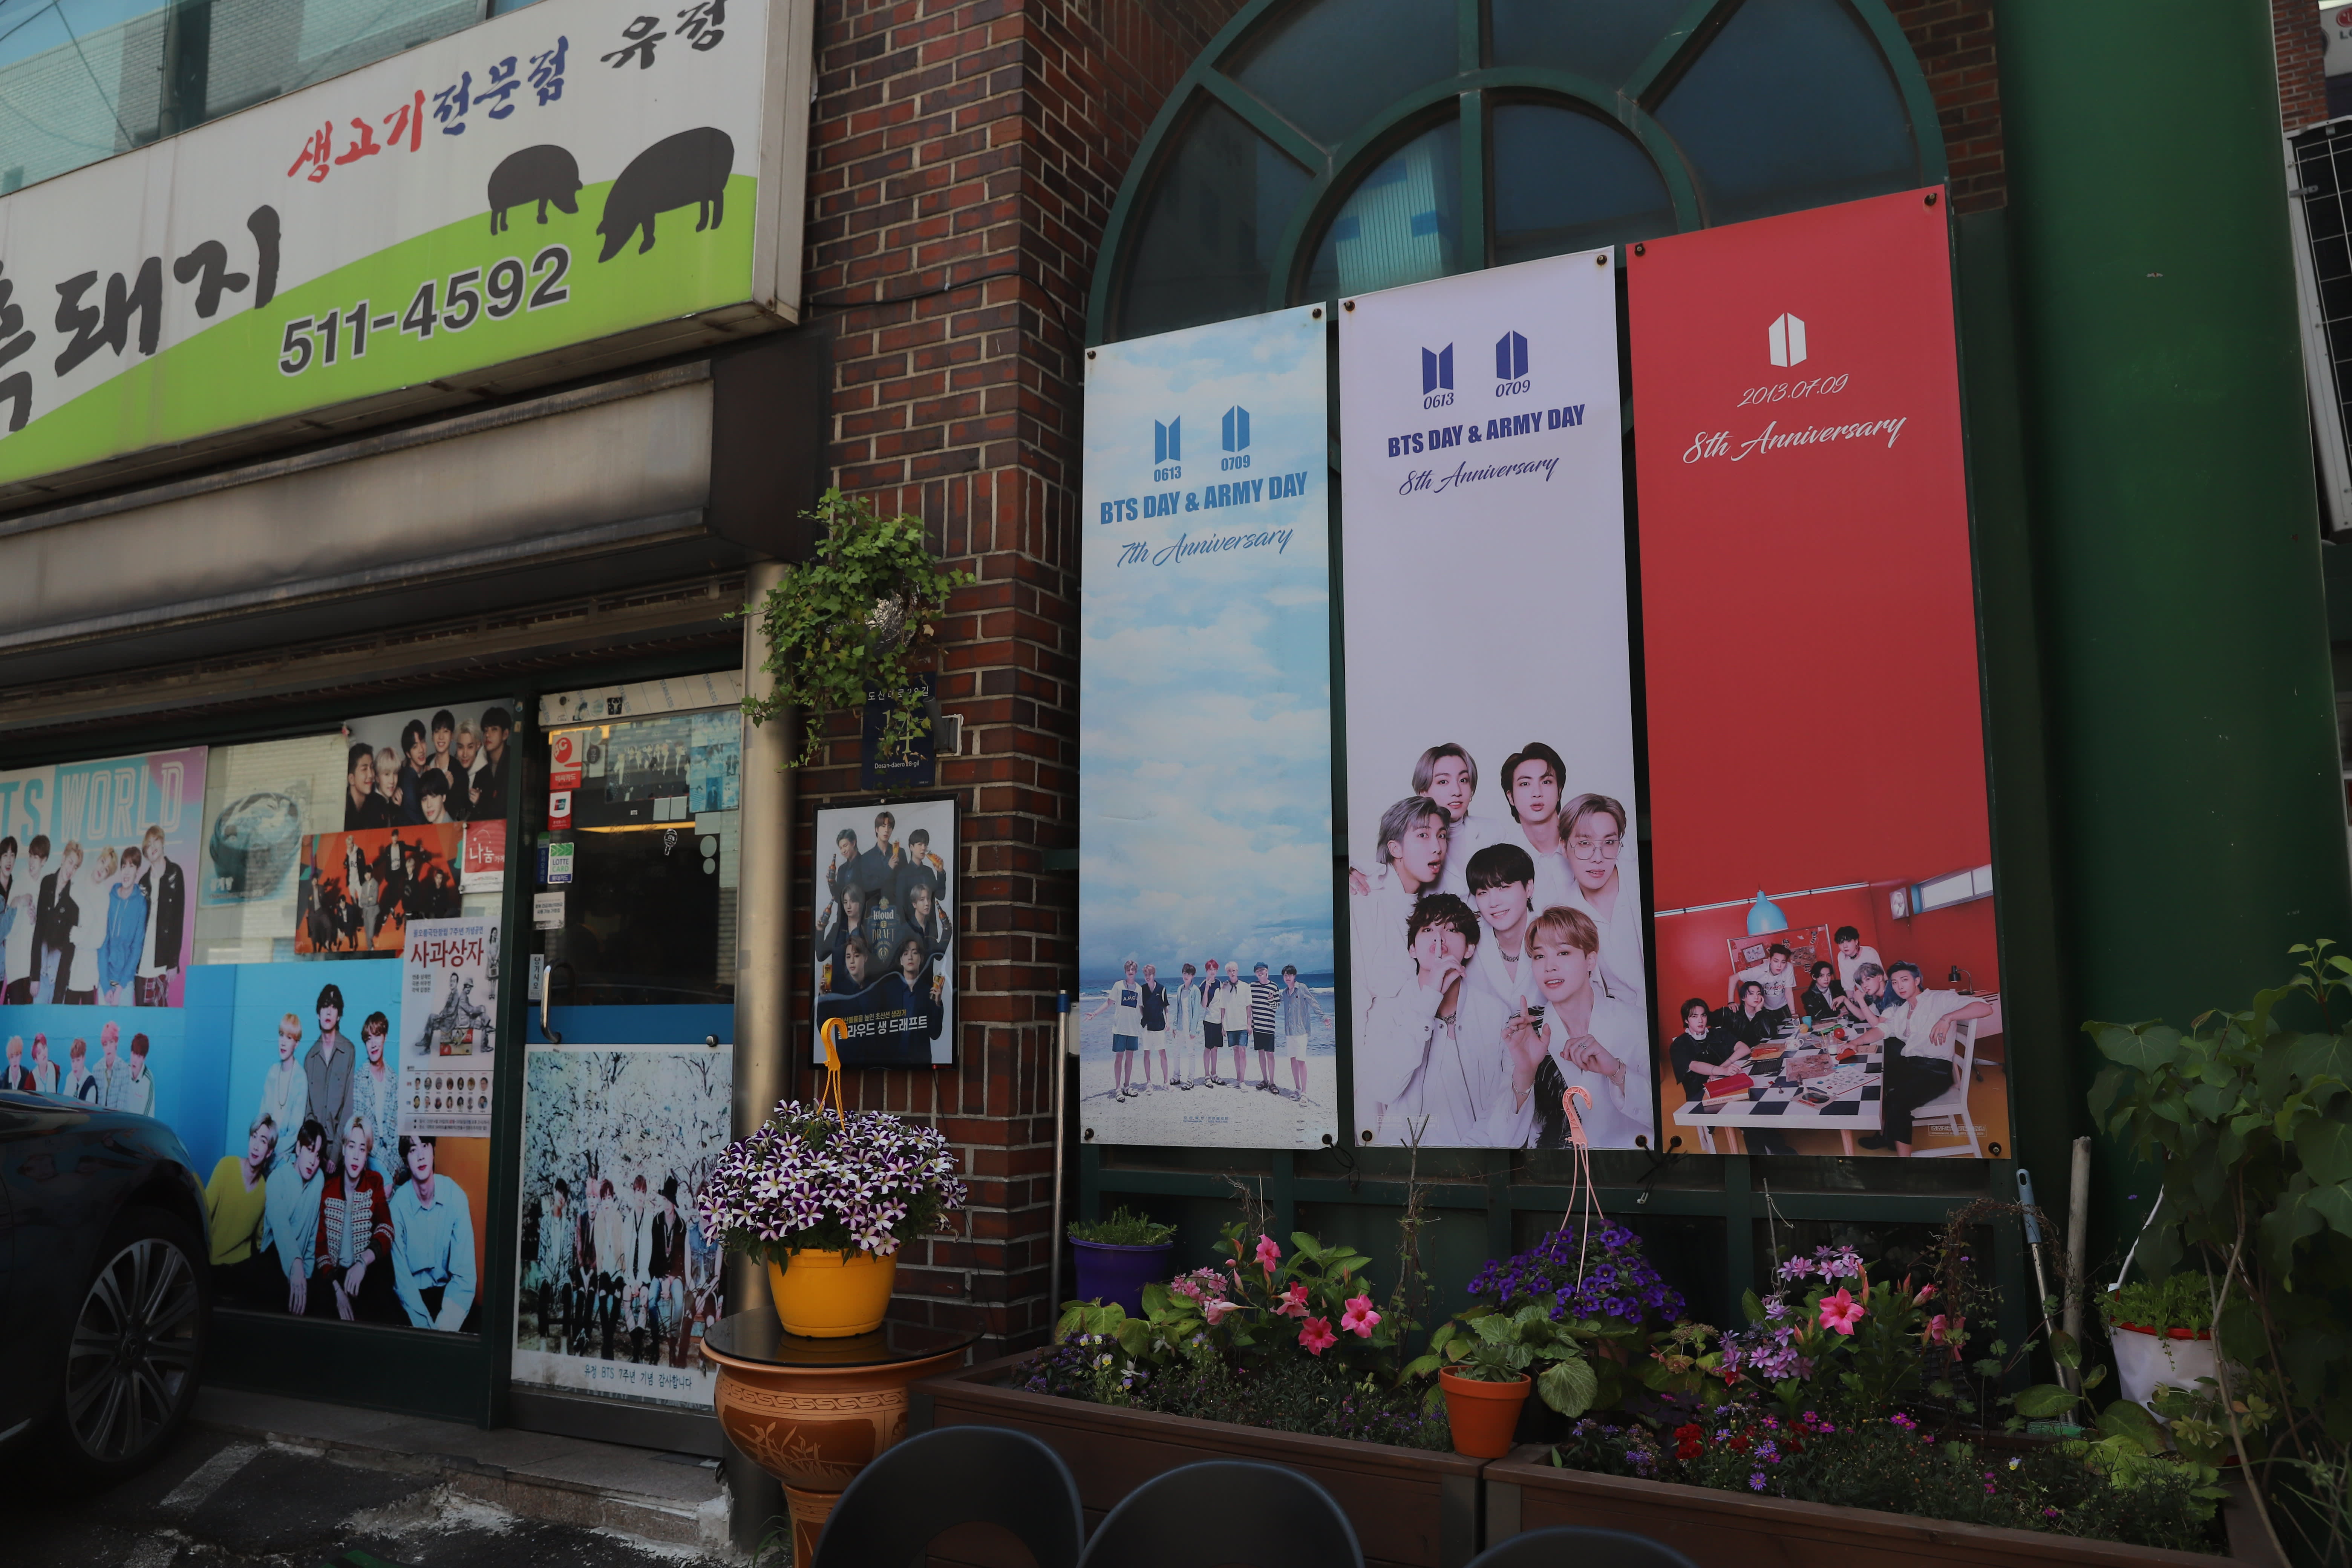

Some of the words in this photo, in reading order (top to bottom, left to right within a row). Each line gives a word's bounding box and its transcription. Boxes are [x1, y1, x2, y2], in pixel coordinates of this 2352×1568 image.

[2340, 27, 2352, 40] L
[279, 244, 570, 376] 511-4592
[1495, 380, 1530, 397] 0709
[1736, 373, 1849, 407] 2013.07.09
[1423, 392, 1454, 409] 0613
[1388, 433, 1424, 458] BTS
[1429, 425, 1463, 451] DAY
[1468, 426, 1482, 443] &
[1486, 411, 1542, 440] ARMY
[1548, 404, 1585, 430] DAY
[1682, 431, 1735, 464] 8th
[1730, 416, 1907, 462] Anniversary
[1154, 466, 1182, 482] 0613
[1221, 455, 1250, 471] 0709
[1399, 470, 1434, 495] 8th
[1433, 457, 1559, 493] Anniversary
[1100, 498, 1138, 525] BTS
[1144, 492, 1180, 518] DAY
[1185, 492, 1199, 512] &
[1204, 478, 1263, 509] ARMY
[1268, 471, 1308, 500] DAY
[1117, 541, 1150, 568] 7th
[1152, 528, 1293, 566] Anniversary
[61, 761, 184, 843] WORLD
[470, 843, 495, 864] 나눔
[873, 909, 894, 920] Kloud
[872, 928, 895, 944] DRAFT
[411, 938, 484, 968] 사과상자
[864, 1013, 874, 1021] 높인
[875, 1012, 890, 1020] 초신선
[891, 1009, 906, 1018] 생라거
[877, 1020, 887, 1035] 생
[889, 1015, 928, 1033] 드래프트
[585, 1364, 597, 1378] 유정
[602, 1367, 614, 1379] BTS
[619, 1369, 635, 1384] 7주년
[640, 1371, 653, 1386] 기념
[659, 1373, 692, 1390] 감사합니다
